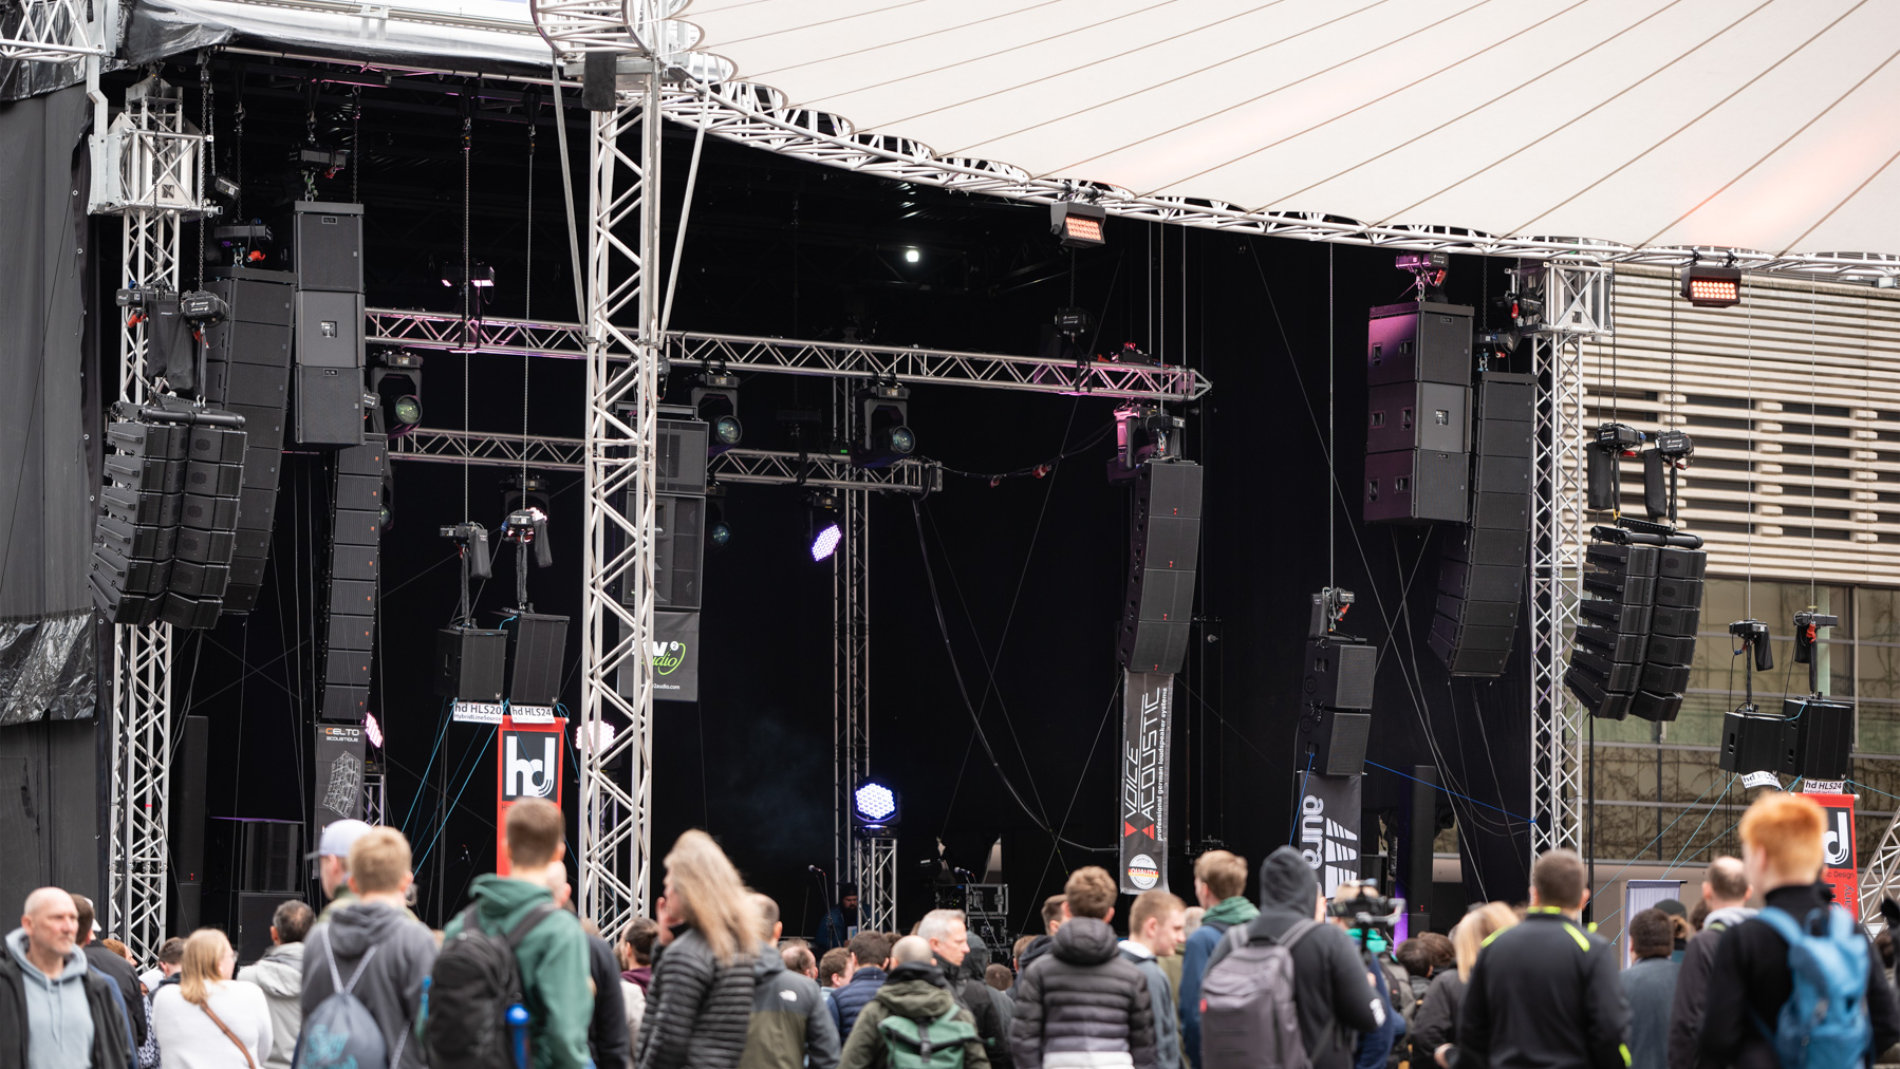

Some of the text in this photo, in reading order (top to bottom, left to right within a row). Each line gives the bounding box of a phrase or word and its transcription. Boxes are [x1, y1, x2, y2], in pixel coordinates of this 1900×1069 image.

[455, 703, 502, 715] hd HLS20
[512, 707, 551, 716] hd HLS24
[1160, 687, 1168, 718] systems
[325, 727, 359, 736] CELTO
[1158, 719, 1166, 765] loudspeaker
[506, 736, 556, 797] hd
[1141, 686, 1160, 821] ACOUSTIC
[1125, 741, 1139, 818] VOICE
[1805, 780, 1842, 790] hd HLS24
[1156, 796, 1164, 841] professional
